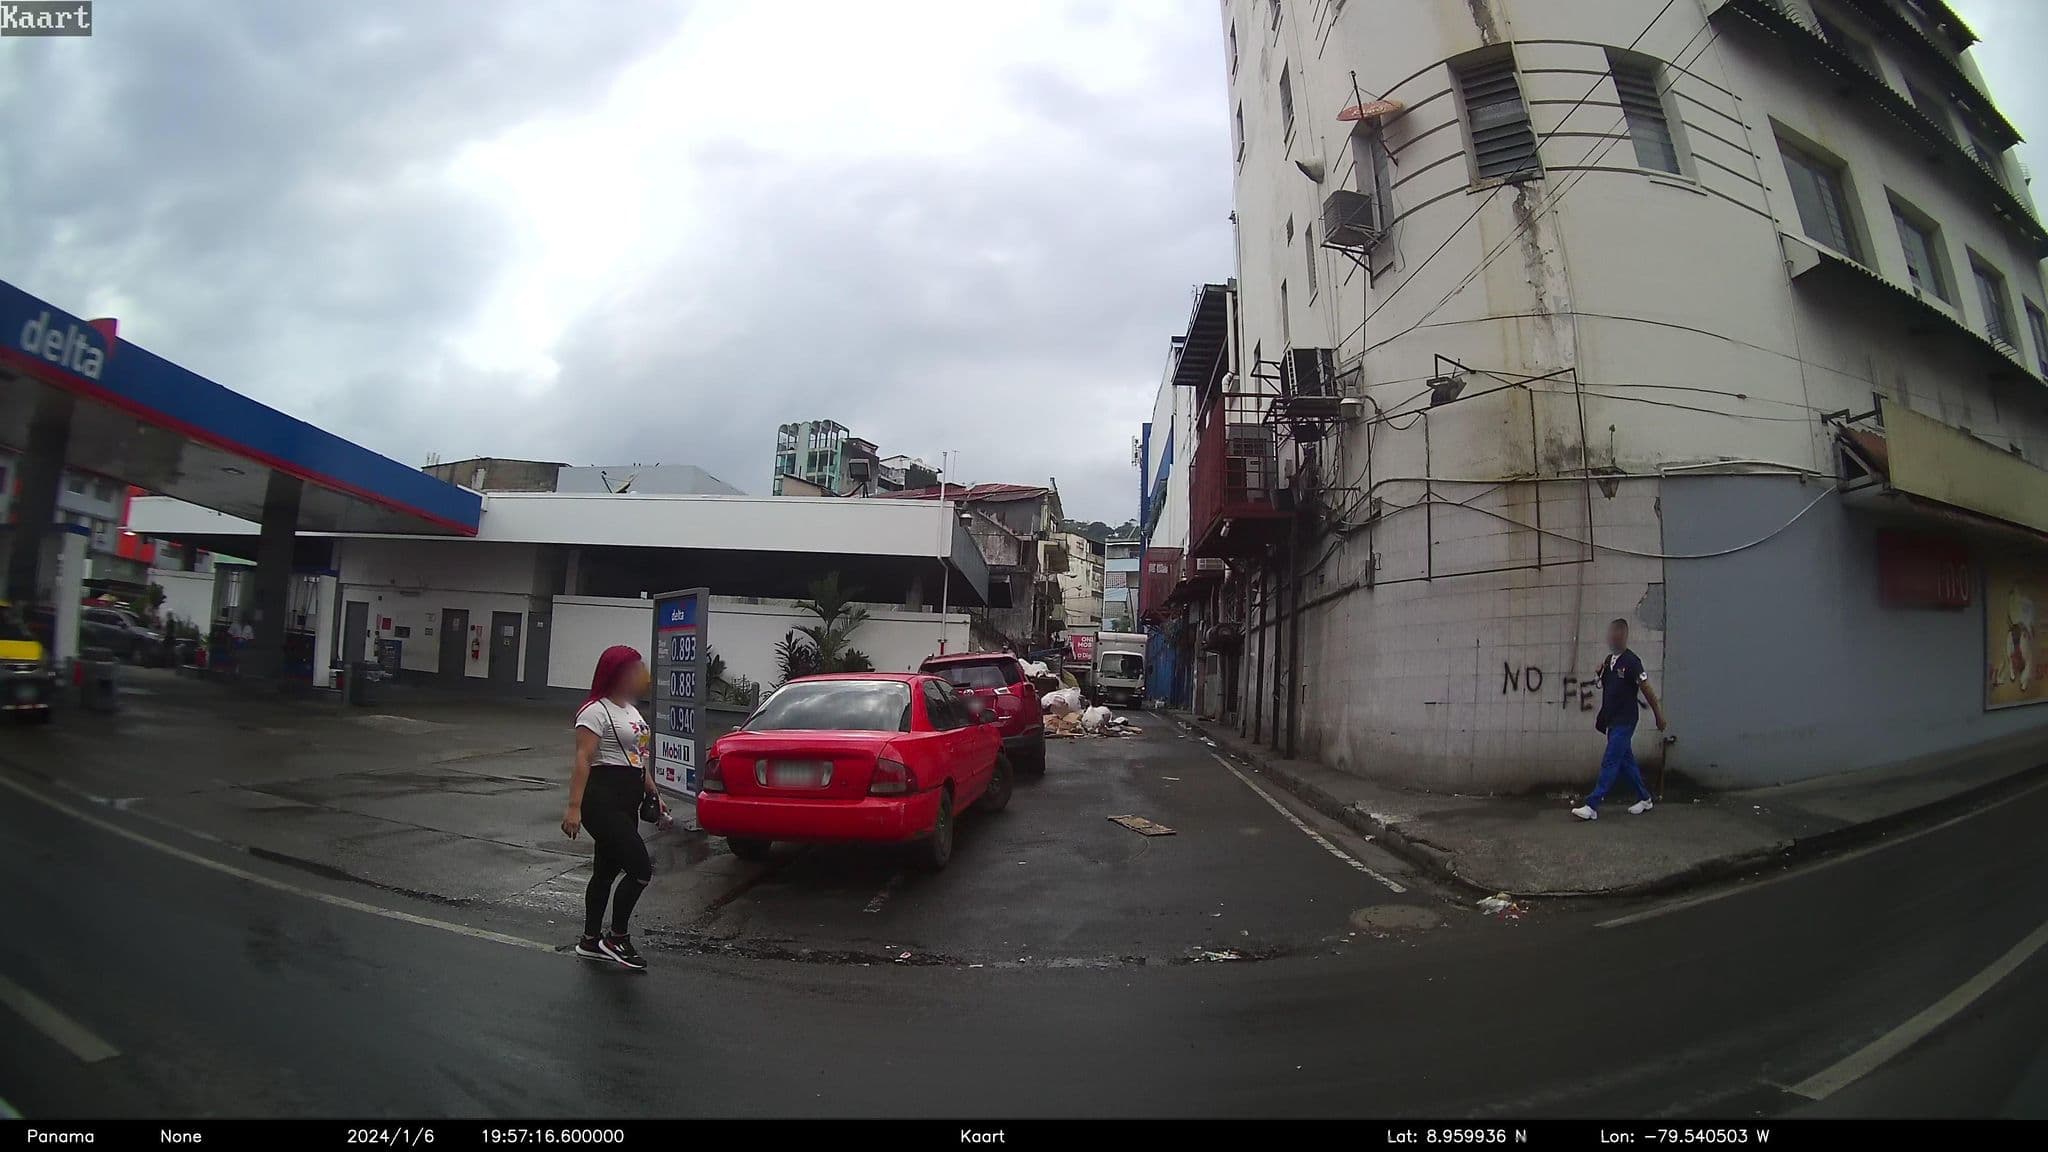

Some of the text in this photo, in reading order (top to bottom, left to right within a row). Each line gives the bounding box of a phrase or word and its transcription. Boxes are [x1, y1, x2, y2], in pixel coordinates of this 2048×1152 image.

[20, 311, 105, 380] delta
[671, 609, 685, 621] delta
[671, 636, 697, 661] 0.893
[1502, 661, 1598, 713] NO FE
[662, 741, 682, 761] Mobil
